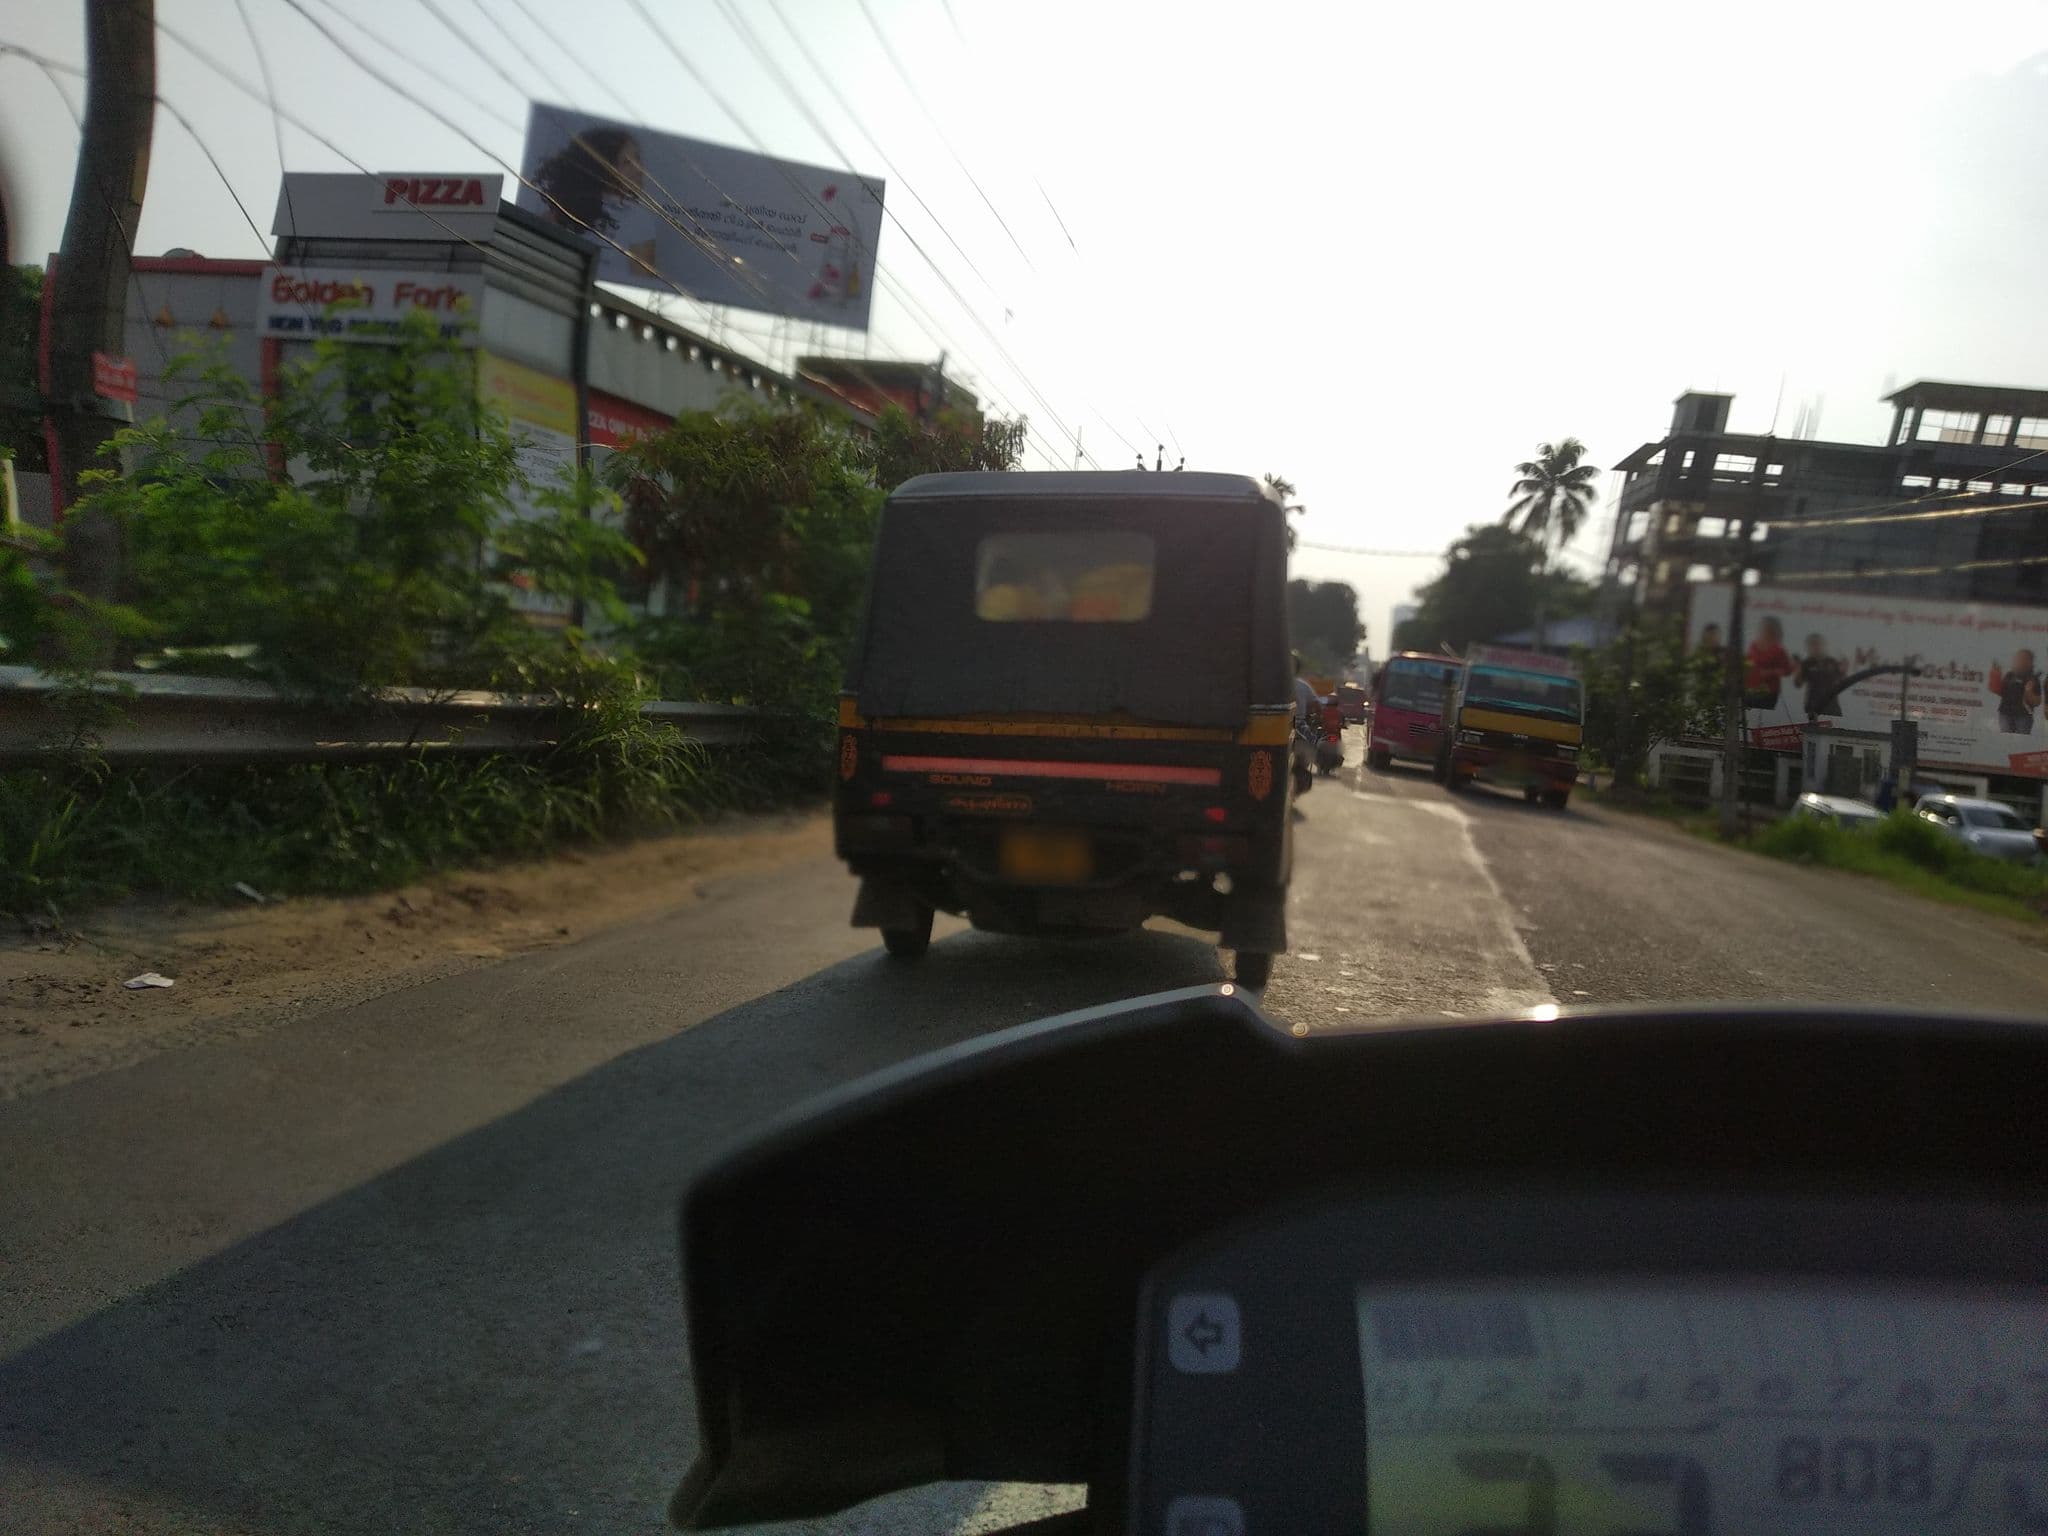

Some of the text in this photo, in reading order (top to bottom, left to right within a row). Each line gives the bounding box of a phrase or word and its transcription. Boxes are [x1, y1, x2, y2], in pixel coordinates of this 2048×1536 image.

[384, 178, 484, 206] PIZZA
[272, 275, 465, 312] Golden Fork
[928, 774, 993, 787] SOUND
